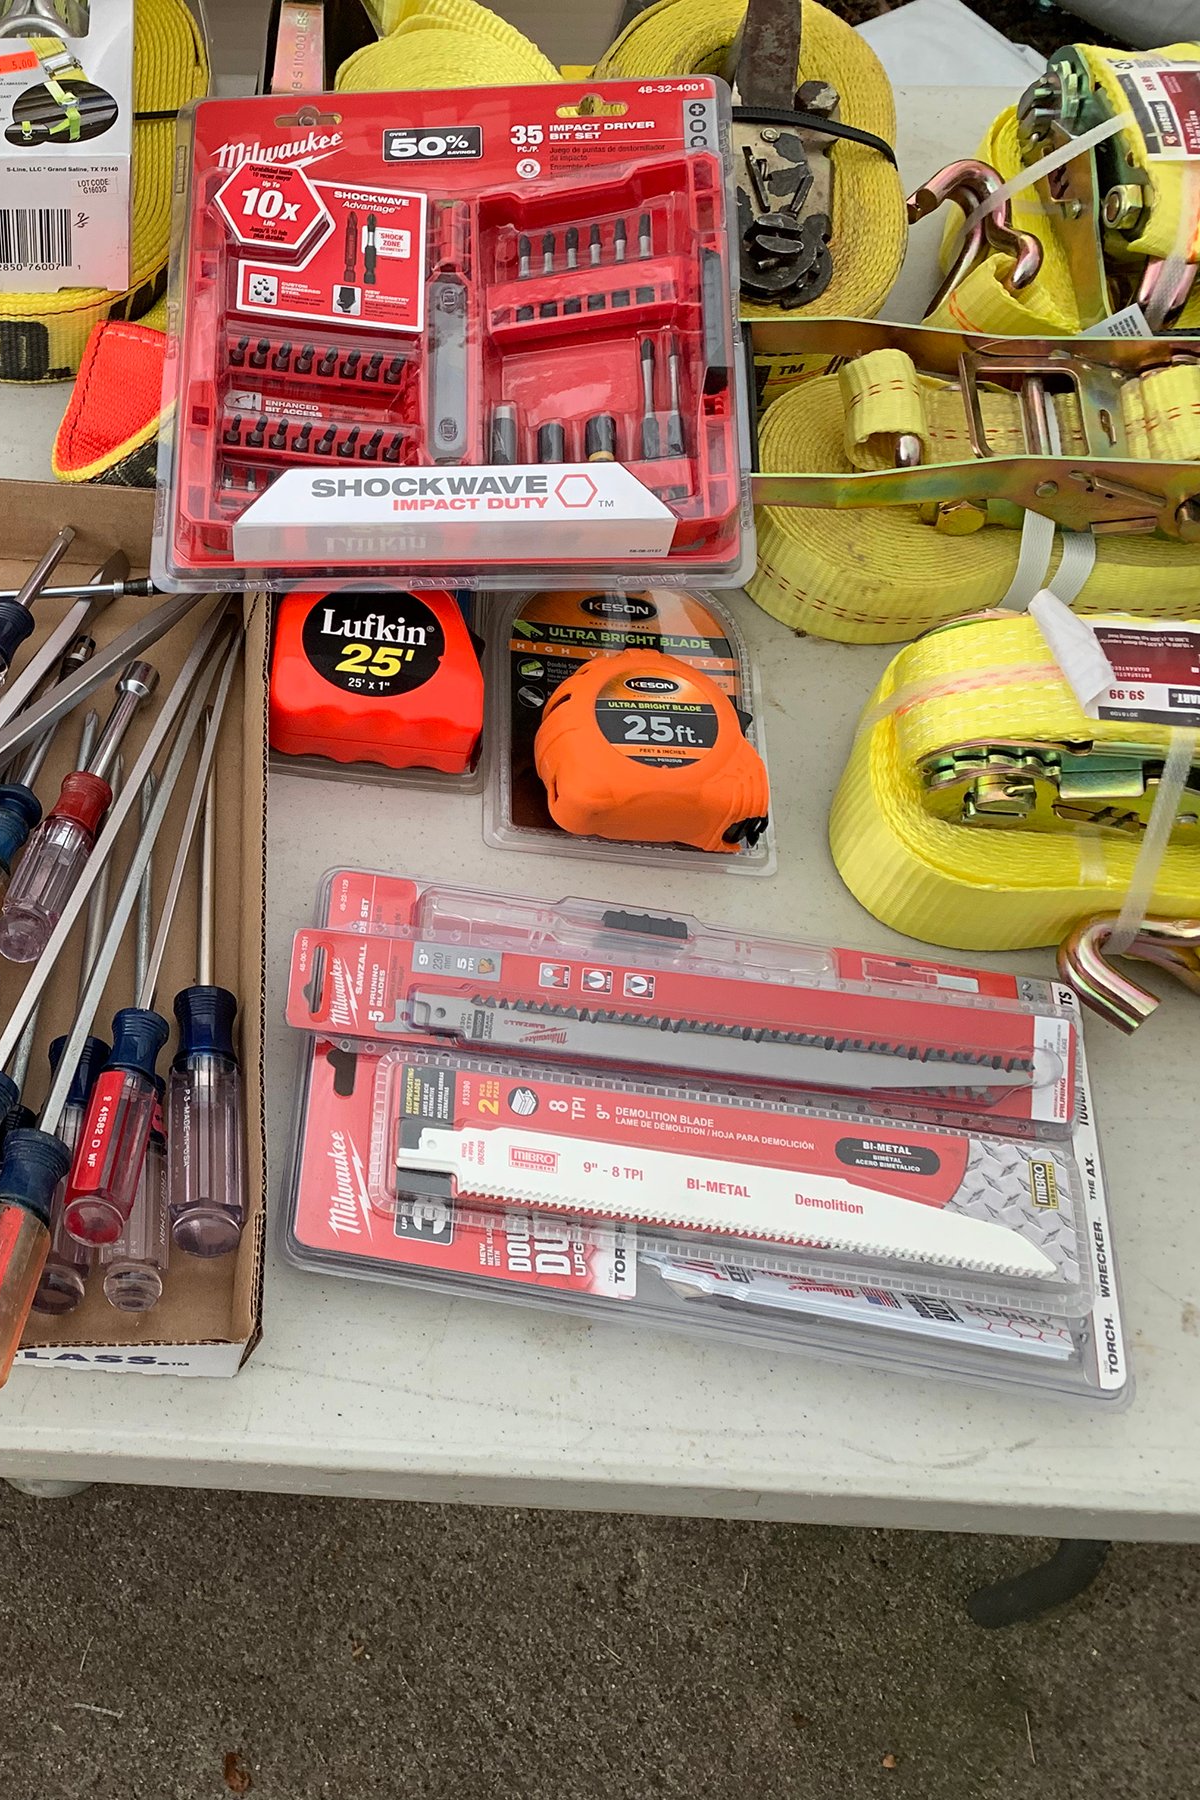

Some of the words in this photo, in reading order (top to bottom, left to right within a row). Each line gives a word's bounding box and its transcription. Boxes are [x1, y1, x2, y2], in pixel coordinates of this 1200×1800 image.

[12, 59, 33, 70] 5.00
[638, 83, 705, 94] 48-32-4001
[510, 124, 543, 145] 35
[550, 123, 600, 132] IMPACT
[604, 121, 655, 130] DRIVER
[550, 132, 572, 140] BIT
[210, 131, 343, 168] Milwaukee
[390, 135, 469, 158] 50%
[582, 146, 605, 154] puntas
[561, 154, 588, 162] impacto
[78, 179, 91, 188] LOT
[91, 178, 109, 187] CODE
[262, 180, 271, 188] Up
[242, 187, 301, 221] 10x
[333, 190, 410, 207] SHOCKWAVE
[380, 233, 404, 241] SHOCK
[28, 263, 61, 271] 76007
[265, 400, 319, 411] ENHANCED
[265, 406, 281, 414] BIT
[283, 407, 323, 418] ACCESS
[311, 475, 548, 498] SHOCKWAVE
[393, 498, 480, 511] IMPACT
[487, 496, 548, 510] DUTY
[589, 601, 649, 615] KESON
[321, 608, 427, 647] Lufkin
[549, 626, 596, 640] ULTRA
[601, 631, 656, 646] BRIGHT
[660, 636, 710, 650] BLADE
[516, 643, 570, 655] HIGH
[335, 643, 414, 677] 25'
[348, 677, 365, 688] 25'
[368, 680, 374, 688] x
[631, 681, 674, 690] KESON
[1110, 689, 1145, 700] $9.99
[672, 704, 702, 712] BLADE
[361, 898, 369, 917] SET
[300, 936, 309, 972] 48-00-1301
[418, 949, 429, 965] 9"
[433, 952, 444, 970] 230
[444, 955, 451, 969] mm
[355, 943, 367, 995] SAWZALL
[457, 958, 467, 969] 5
[330, 957, 351, 1027] Milwaukee
[370, 964, 379, 1006] PRUNING
[377, 970, 386, 1007] BLADES
[368, 1010, 385, 1022] 5
[525, 1031, 568, 1044] Milwaukee
[478, 1099, 499, 1116] 2
[548, 1099, 569, 1112] 8
[571, 1096, 586, 1120] TPI
[596, 1104, 610, 1120] 9"
[94, 1106, 110, 1135] 41582
[615, 1106, 677, 1123] DEMOLITION
[680, 1114, 715, 1128] BLADE
[615, 1117, 639, 1127] LAME
[641, 1120, 652, 1129] DE
[654, 1121, 706, 1136] DÉMOLITION
[712, 1130, 735, 1140] HOJA
[736, 1133, 760, 1143] PARA
[761, 1136, 815, 1150] DEMOLICIÓN
[91, 1139, 101, 1148] D
[862, 1141, 912, 1156] BI-METAL
[87, 1153, 97, 1168] WF
[513, 1149, 554, 1164] MIBRO
[855, 1158, 878, 1167] ACERO
[583, 1161, 598, 1173] 9"
[612, 1166, 620, 1177] 8
[623, 1167, 644, 1181] TPI
[1085, 1157, 1096, 1179] AX
[328, 1130, 361, 1236] Milwaukee
[686, 1177, 752, 1198] BI-METAL
[1033, 1164, 1048, 1204] MIBRO
[1089, 1180, 1097, 1200] THE
[795, 1193, 864, 1215] Demolition
[401, 1217, 408, 1229] UP
[1093, 1221, 1111, 1298] WRECKER
[1103, 1318, 1119, 1377] TORCH
